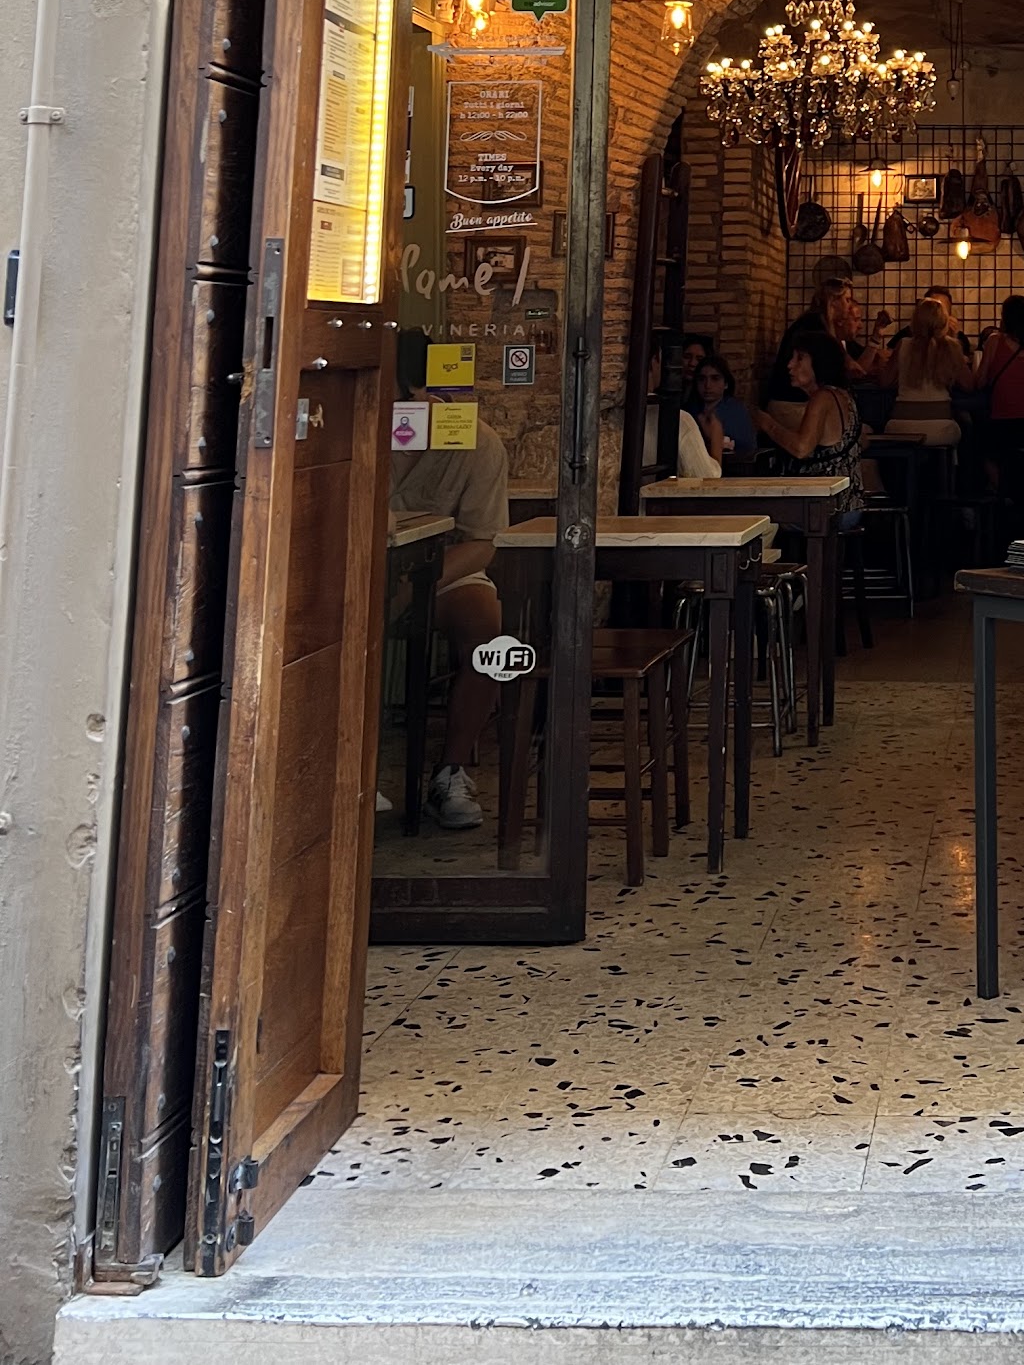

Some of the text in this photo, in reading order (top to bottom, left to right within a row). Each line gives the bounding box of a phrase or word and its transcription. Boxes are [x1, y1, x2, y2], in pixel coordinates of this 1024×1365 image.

[477, 153, 507, 162] TIMES
[470, 163, 514, 173] Every day
[458, 174, 468, 183] 12
[450, 211, 533, 230] Buon appetito
[421, 323, 526, 337] VINERIA
